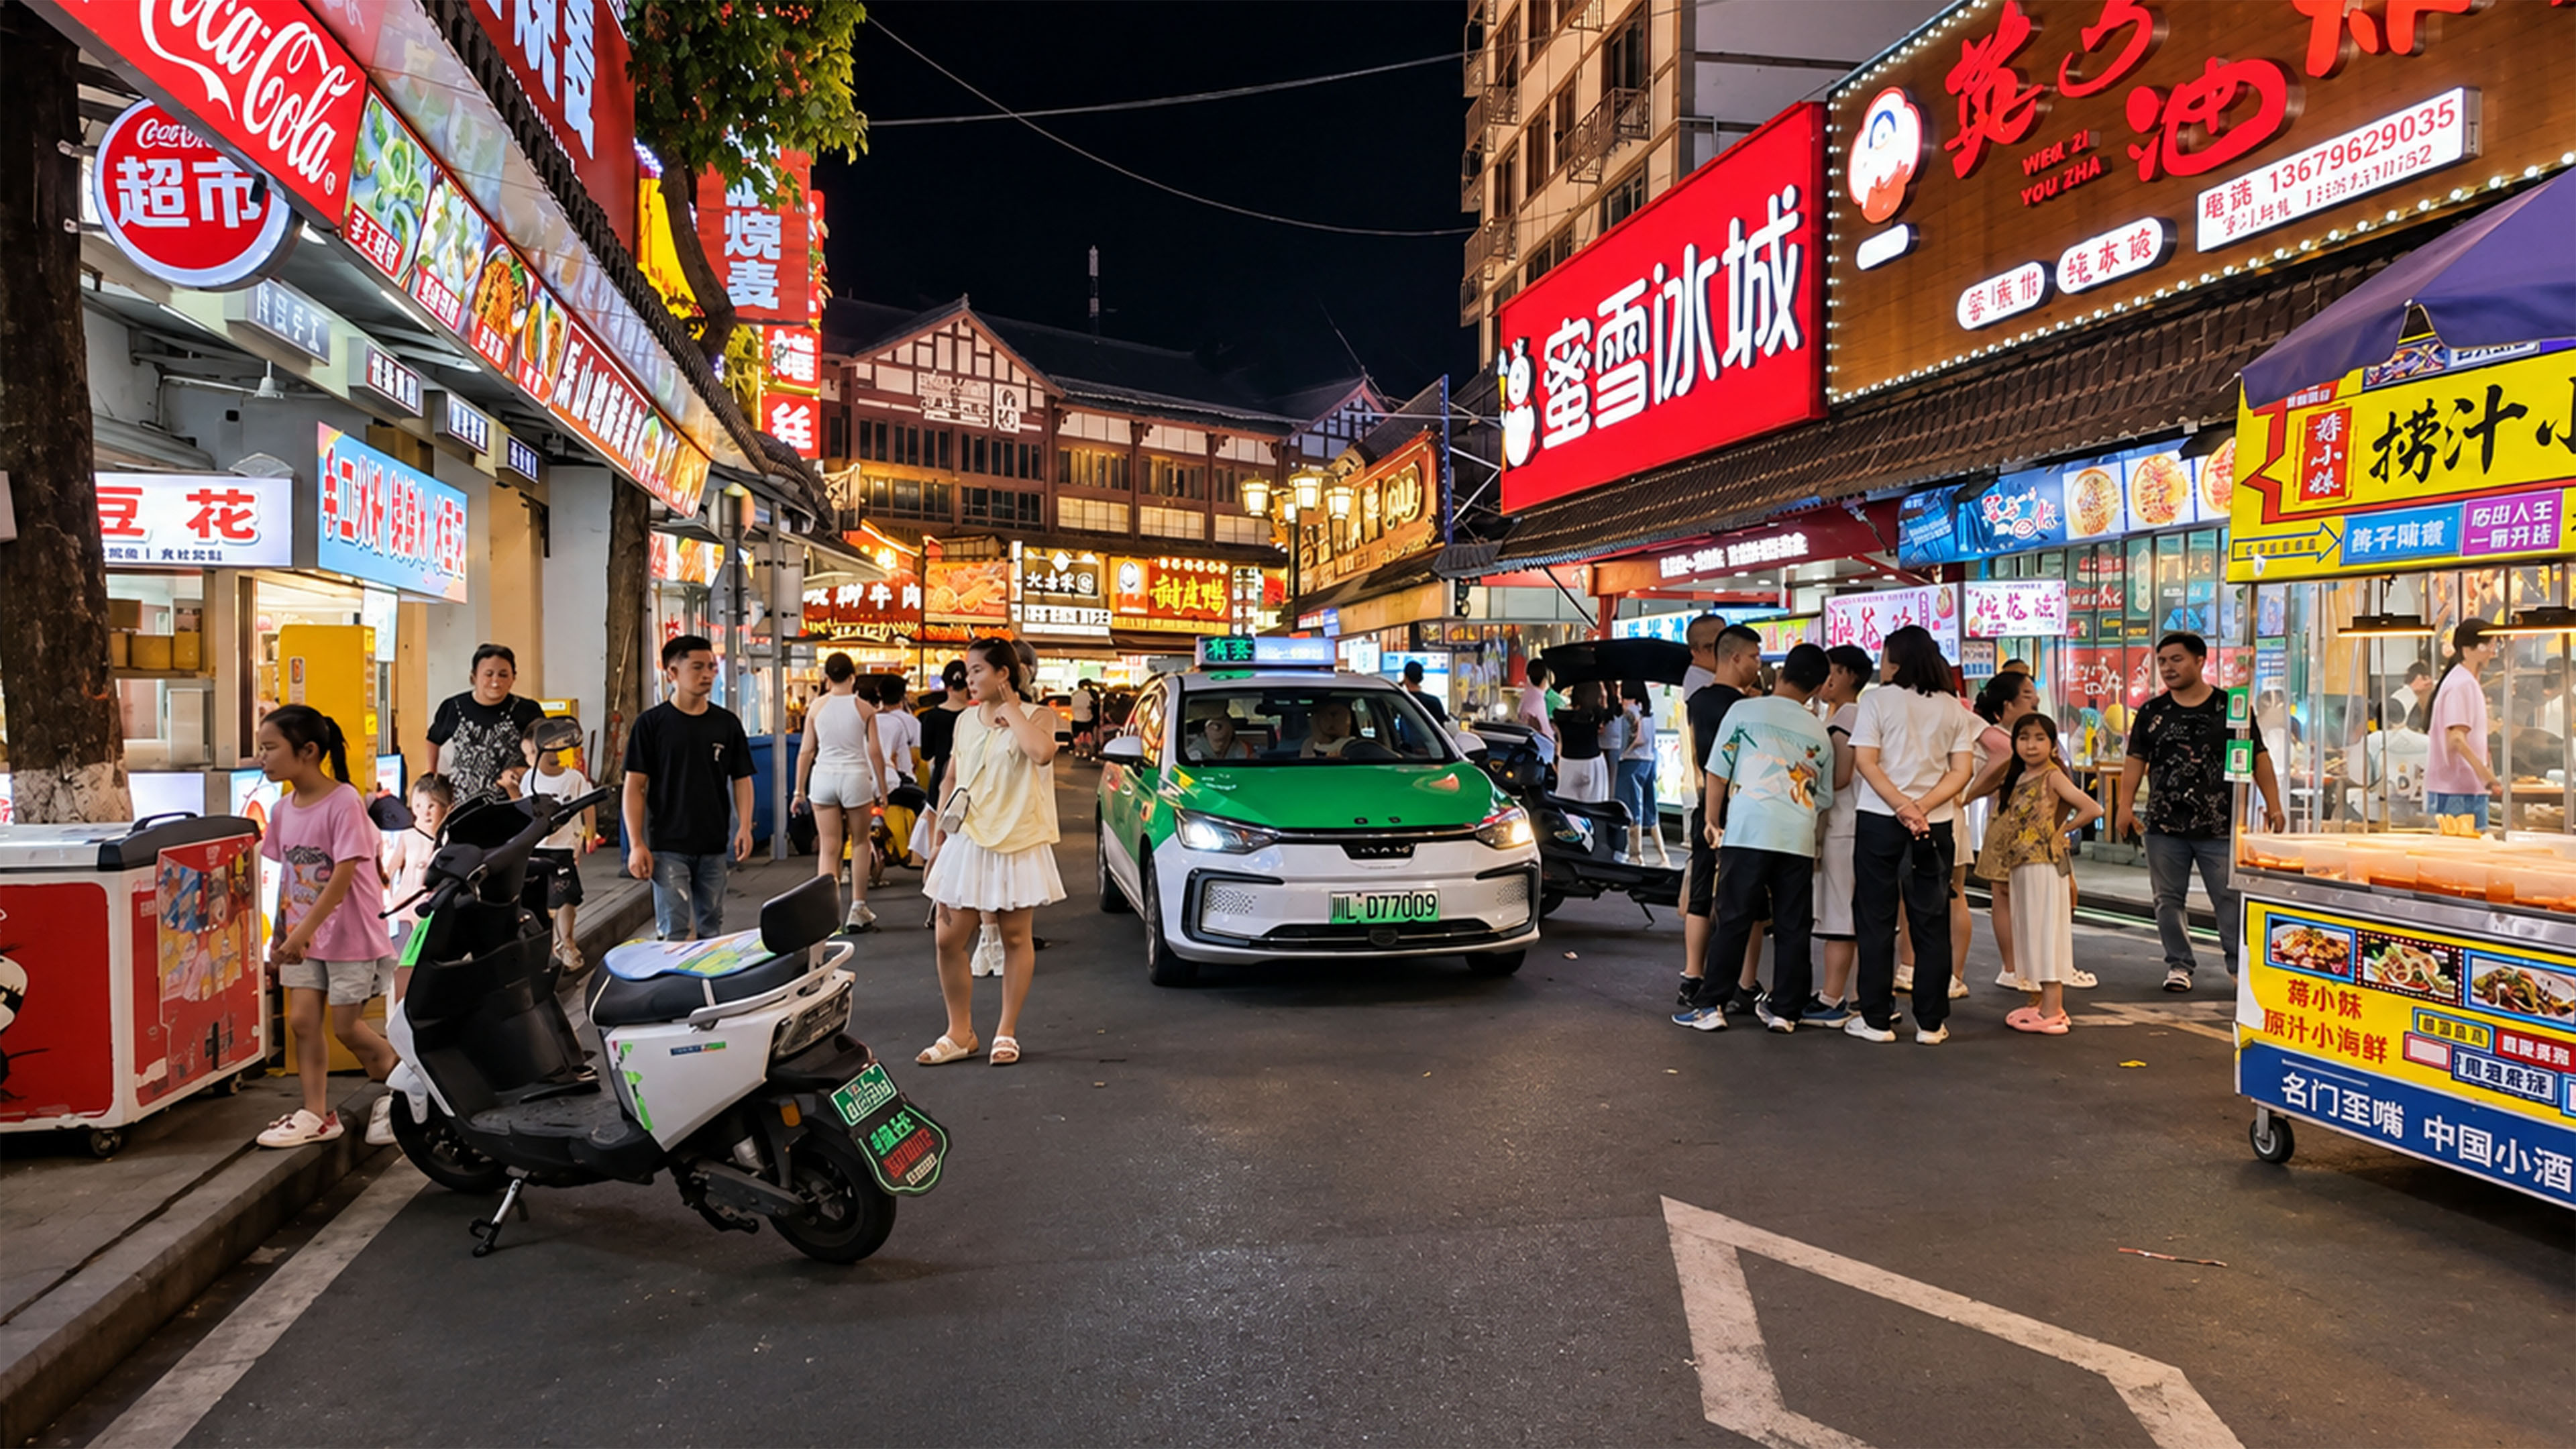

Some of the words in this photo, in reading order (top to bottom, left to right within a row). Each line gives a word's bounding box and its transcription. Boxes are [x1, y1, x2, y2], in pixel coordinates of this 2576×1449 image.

[2021, 176, 2059, 207] YOU
[2061, 155, 2102, 190] ZHA
[2269, 99, 2455, 195] 13679629035
[115, 156, 263, 228] 超市
[1542, 184, 1801, 450] 蜜雪冰城
[2424, 1114, 2573, 1194] 中国小酒
